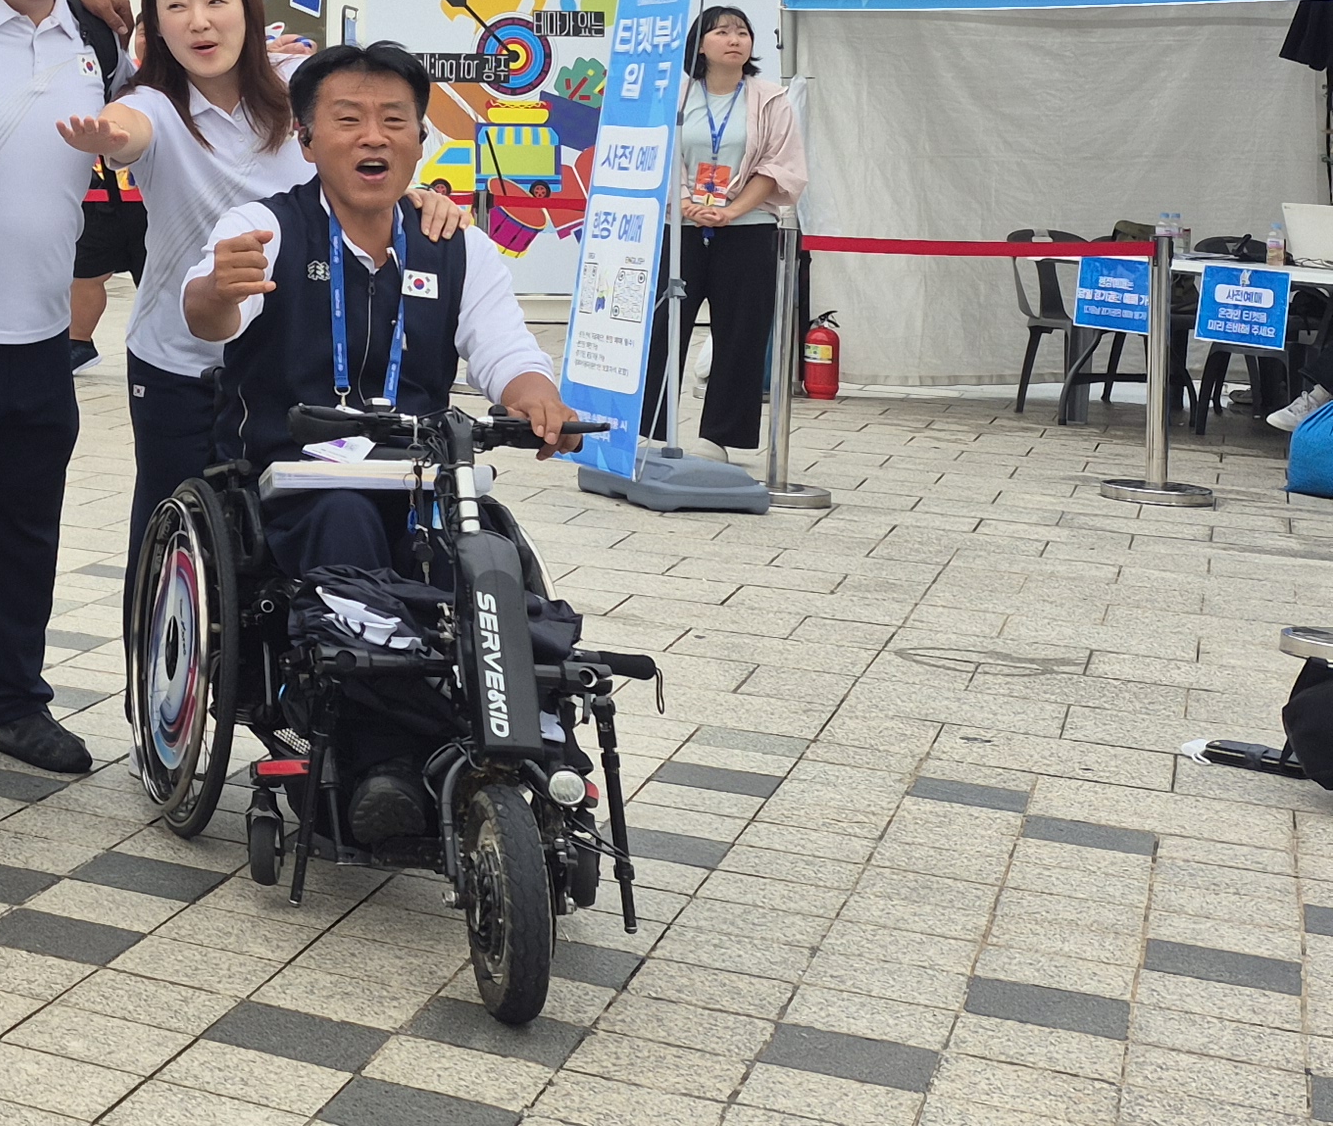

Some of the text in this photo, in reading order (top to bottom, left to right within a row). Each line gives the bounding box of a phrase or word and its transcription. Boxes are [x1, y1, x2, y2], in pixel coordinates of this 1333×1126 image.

[533, 11, 604, 37] 테마가 있는
[459, 54, 479, 79] for
[482, 55, 509, 82] 광주
[601, 144, 634, 171] 사전
